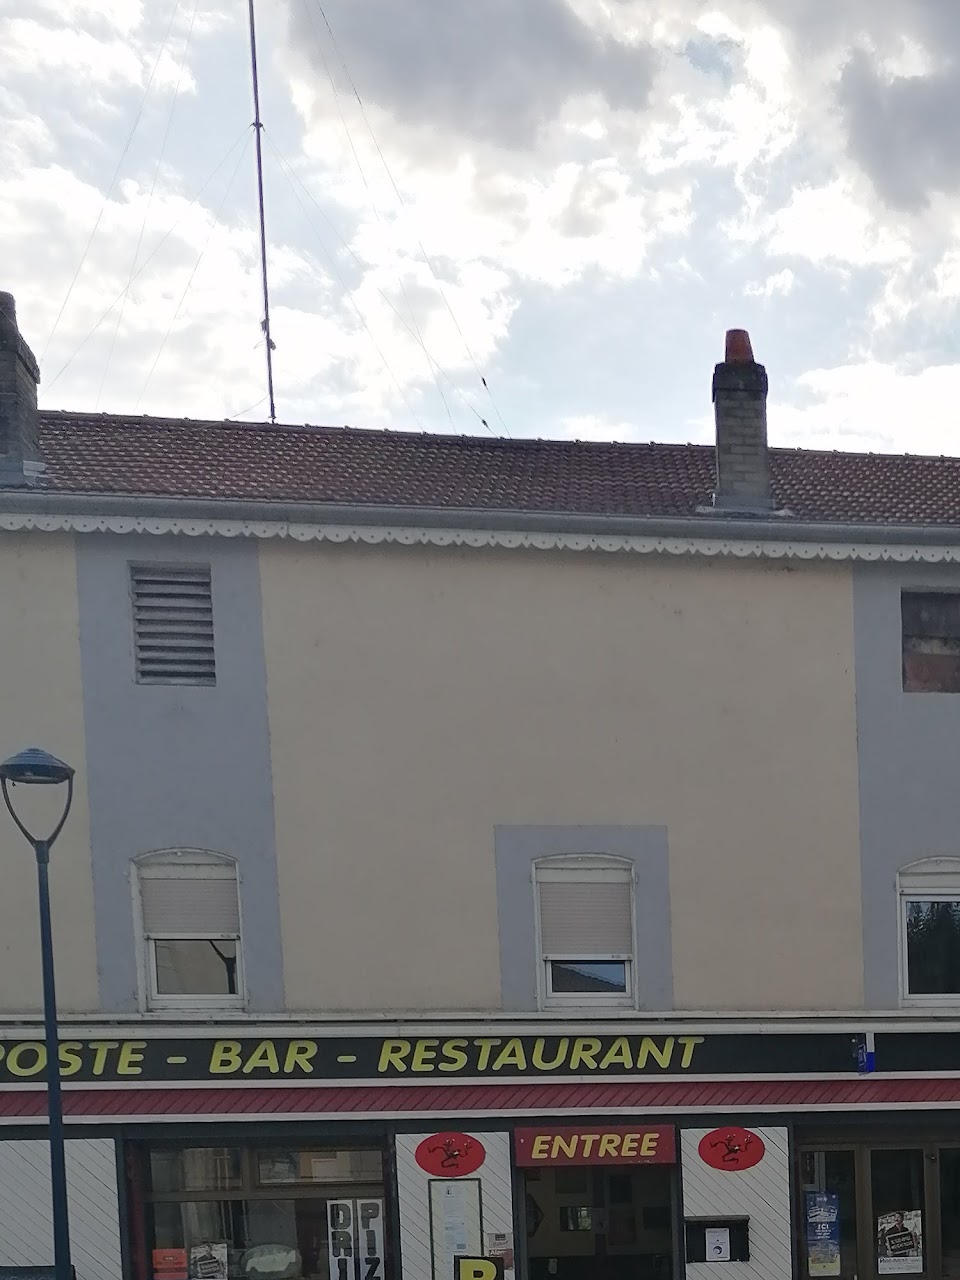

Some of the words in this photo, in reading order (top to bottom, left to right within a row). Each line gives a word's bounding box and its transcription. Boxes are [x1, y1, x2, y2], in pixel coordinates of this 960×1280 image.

[0, 1041, 147, 1077] OSTE
[209, 1040, 318, 1074] BAR
[378, 1036, 704, 1073] RESTAURANT
[531, 1132, 660, 1159] ENTREE
